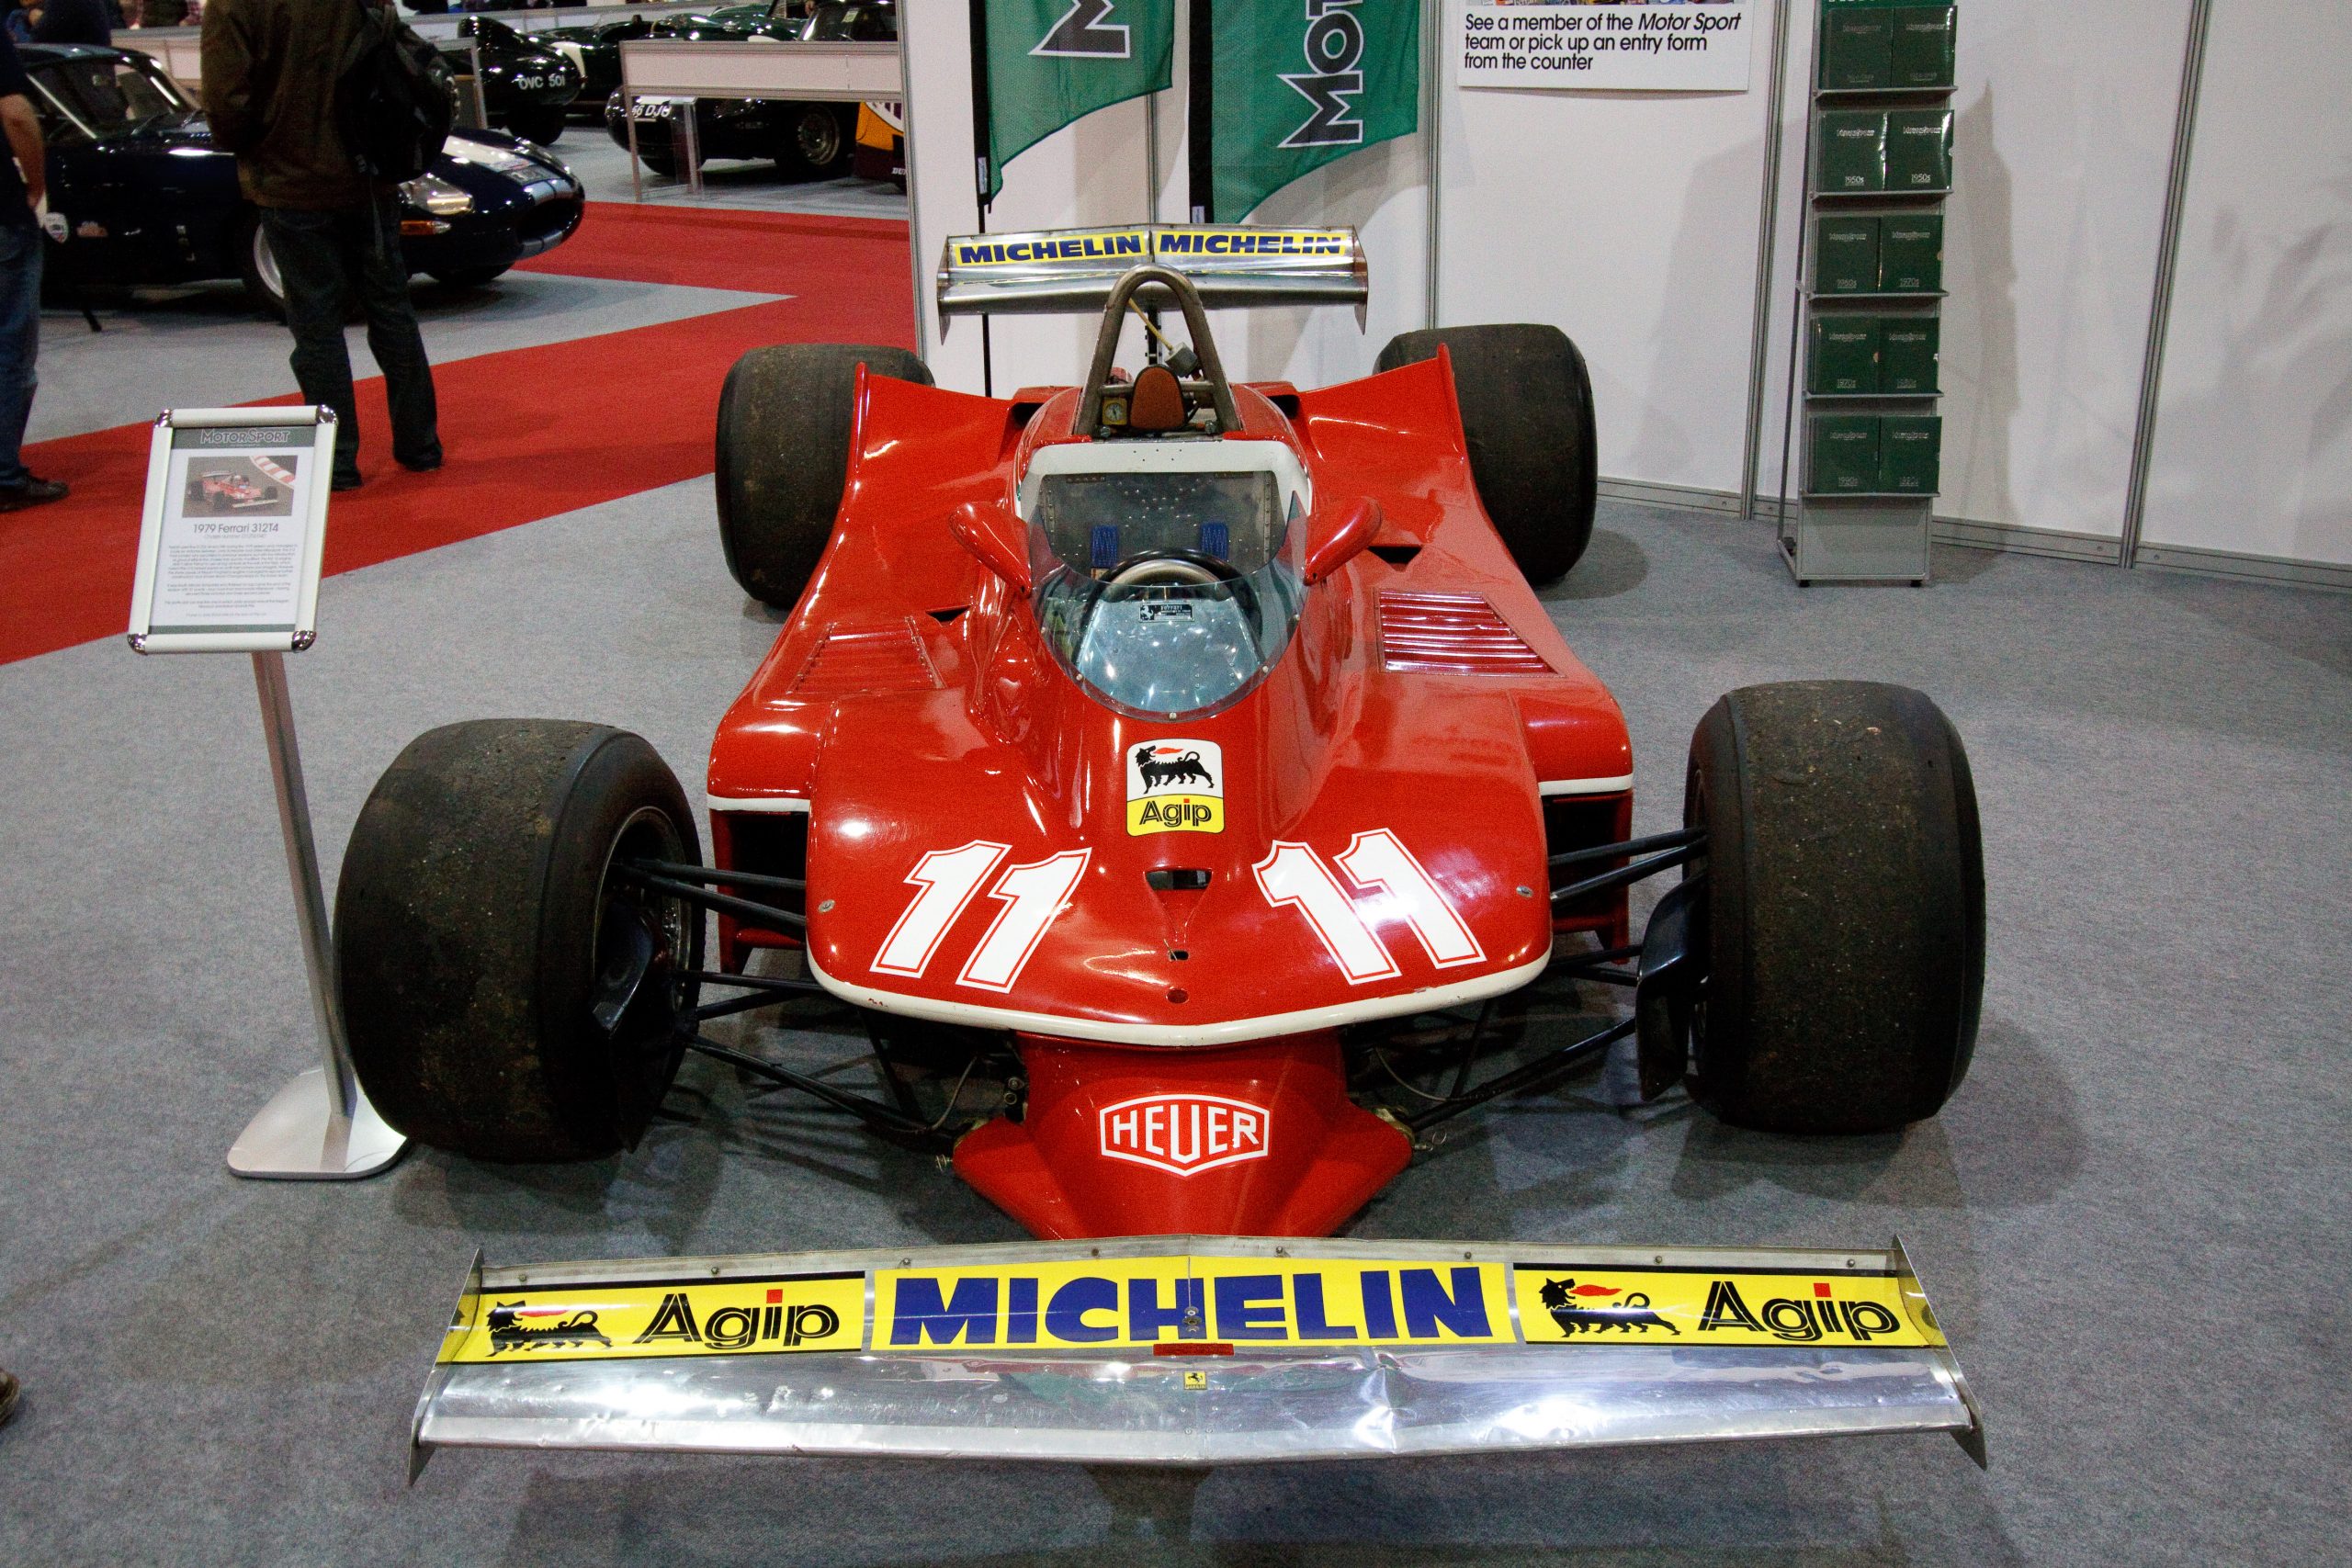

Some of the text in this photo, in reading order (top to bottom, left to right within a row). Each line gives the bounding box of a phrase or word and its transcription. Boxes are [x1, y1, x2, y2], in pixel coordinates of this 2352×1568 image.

[1465, 12, 1741, 34] See a member of the Motor Sport
[1465, 33, 1707, 54] team or pick up an entry form
[1464, 52, 1593, 70] from the counter
[518, 76, 544, 90] OVC
[959, 233, 1341, 264] MICHELIN MICHELIN
[193, 523, 279, 533] 1979 Ferrari 312T4
[1139, 798, 1212, 828] Agip
[870, 839, 1091, 993] 11
[1251, 828, 1487, 986] 11
[1113, 1104, 1260, 1164] HEUER
[632, 1289, 841, 1348] Agip
[889, 1266, 1496, 1345] MICHELIN
[1697, 1282, 1900, 1342] Agip
